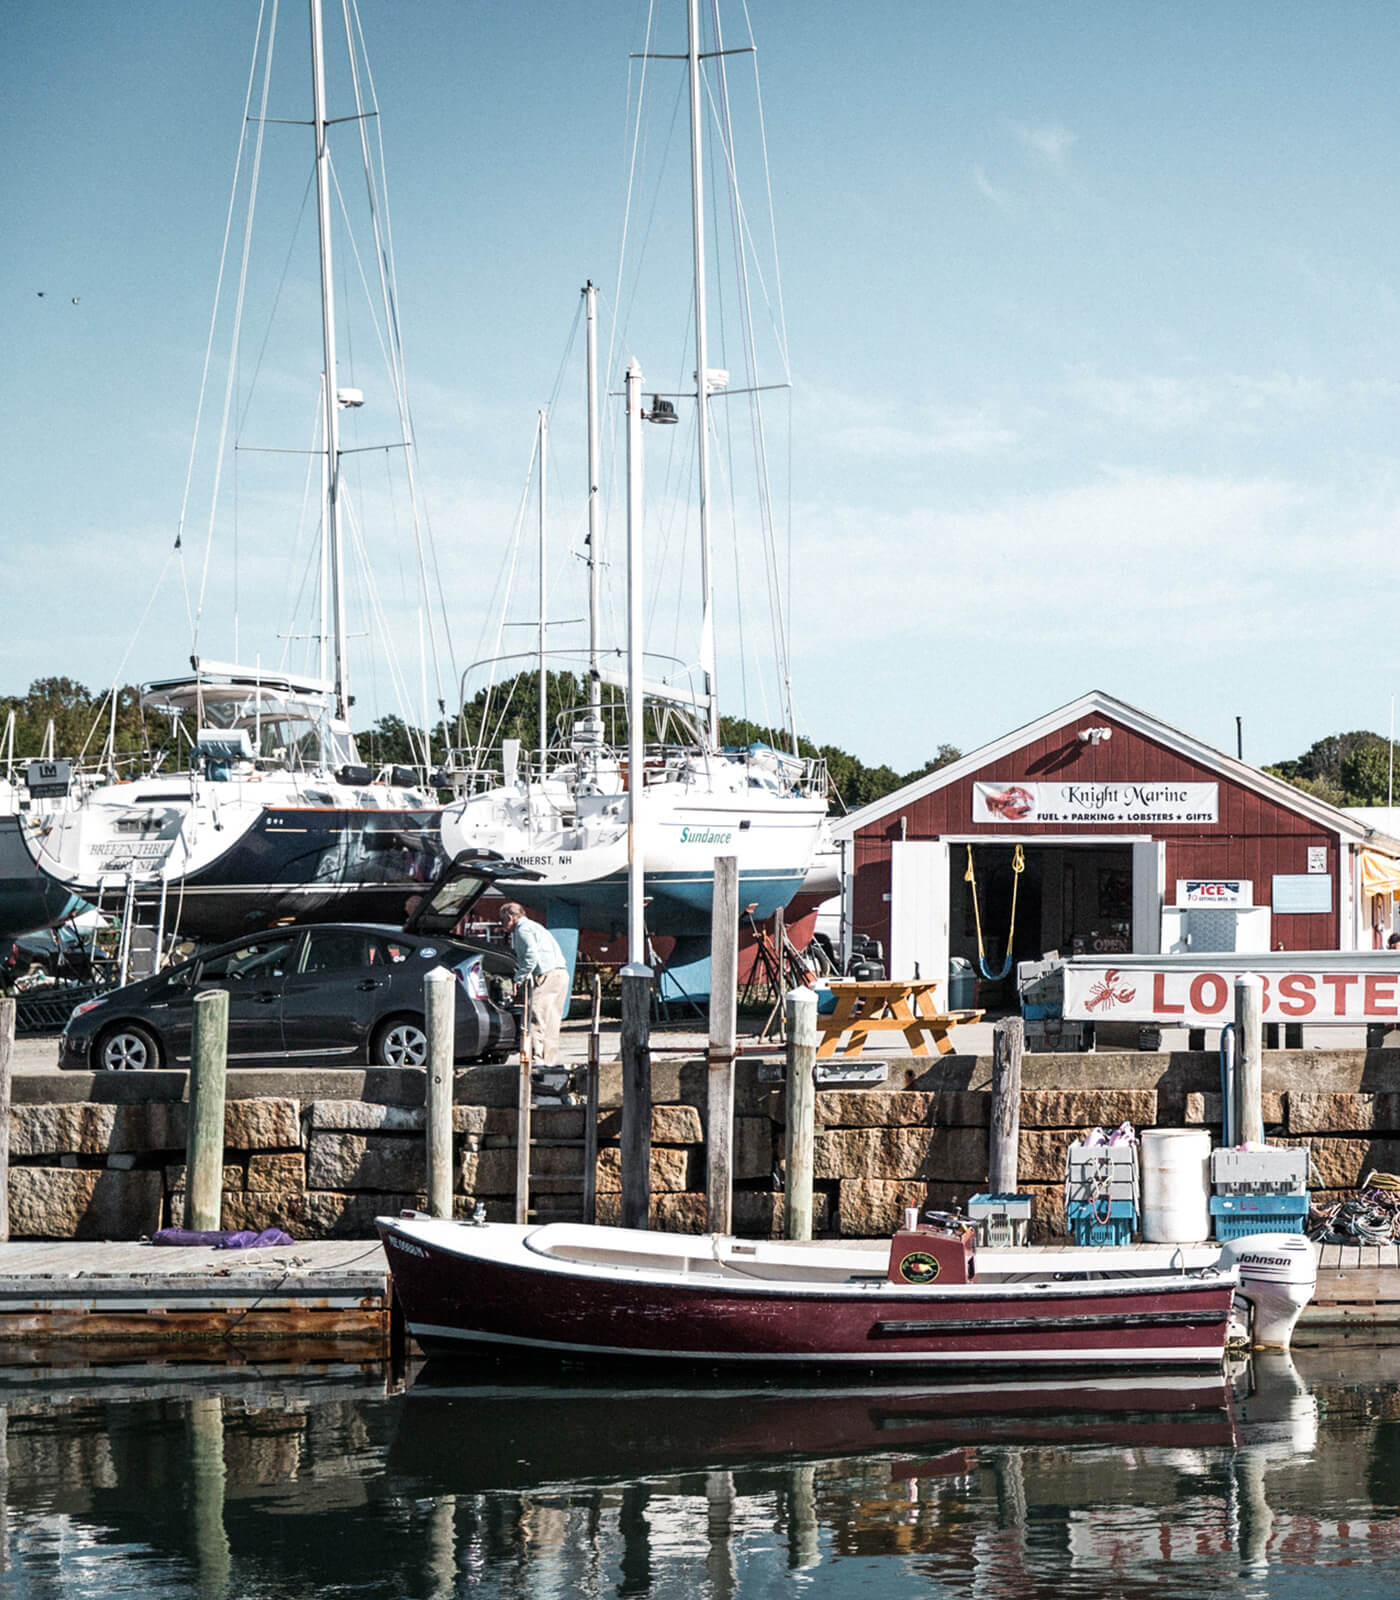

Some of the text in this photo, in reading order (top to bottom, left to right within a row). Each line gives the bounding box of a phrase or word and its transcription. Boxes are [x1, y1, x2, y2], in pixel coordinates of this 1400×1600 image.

[1061, 786, 1188, 808] Knight Marine
[1037, 813, 1213, 821] FUEL PARKING LOBSTERS GIFTS
[680, 826, 732, 844] Sundance
[559, 855, 572, 865] NH
[1200, 885, 1225, 896] ICE
[1236, 1253, 1292, 1266] Johnson
